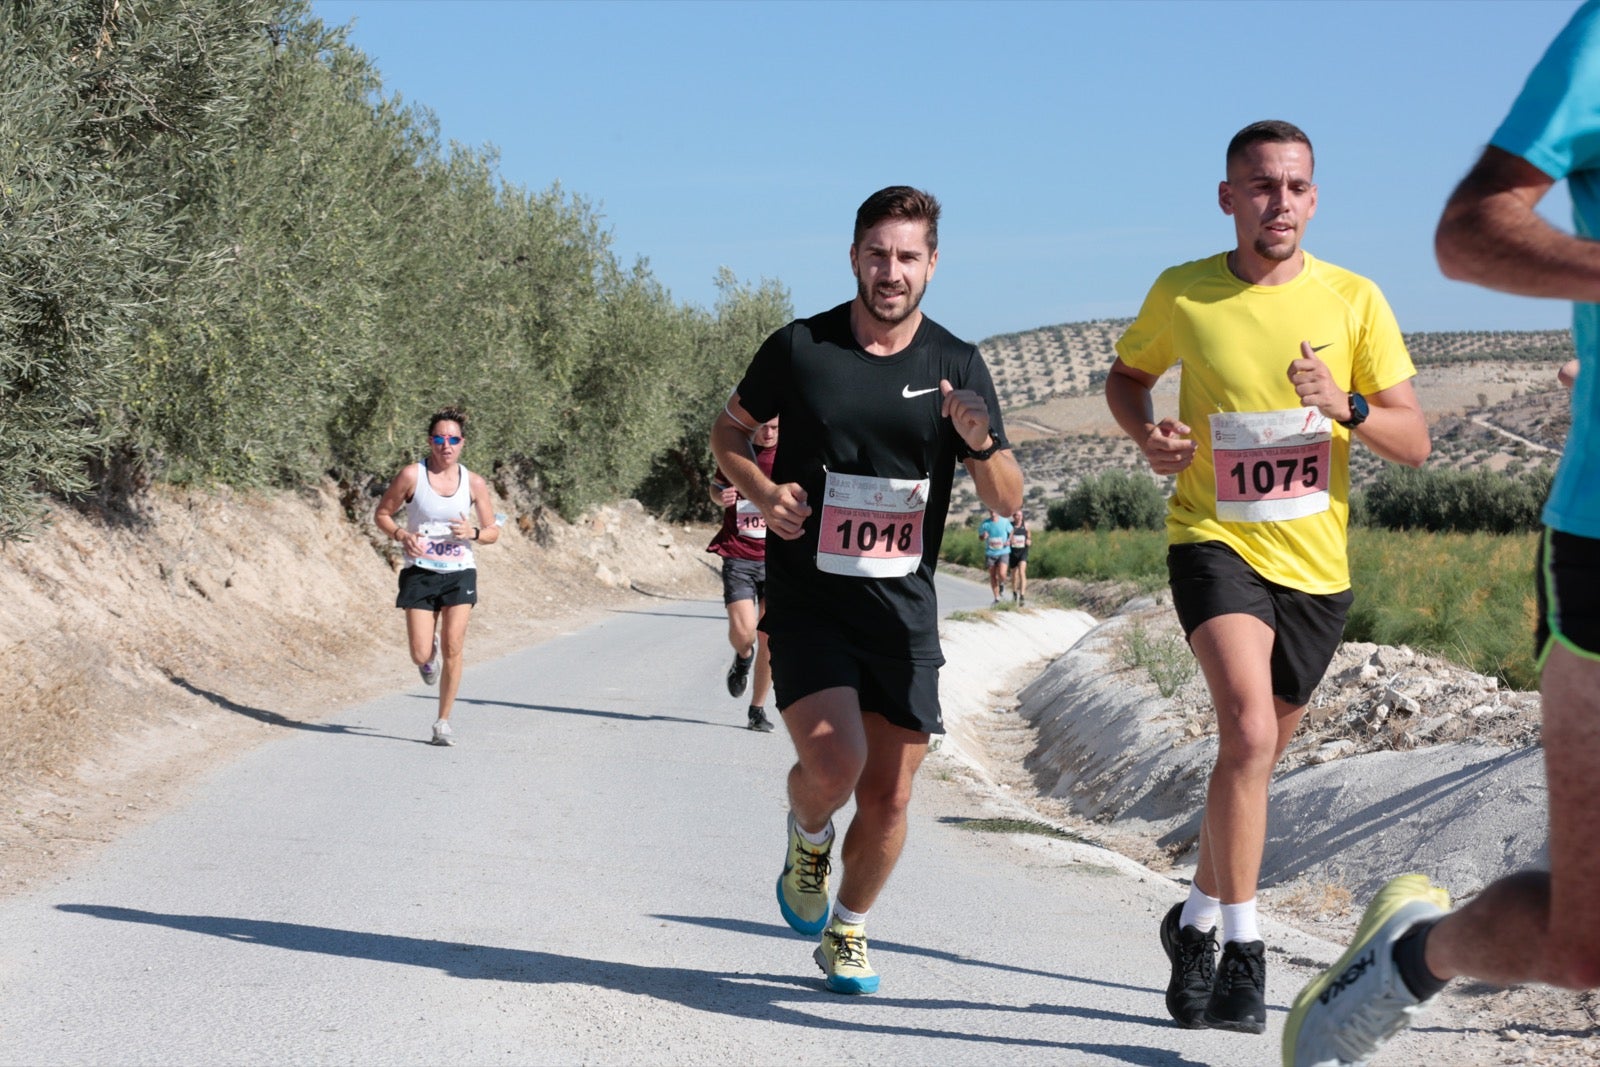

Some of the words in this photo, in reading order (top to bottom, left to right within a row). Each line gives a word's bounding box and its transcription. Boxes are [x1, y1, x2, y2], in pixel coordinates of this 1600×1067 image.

[1231, 455, 1318, 494] 1075
[837, 519, 913, 552] 1018
[1318, 949, 1376, 1005] HOKA
